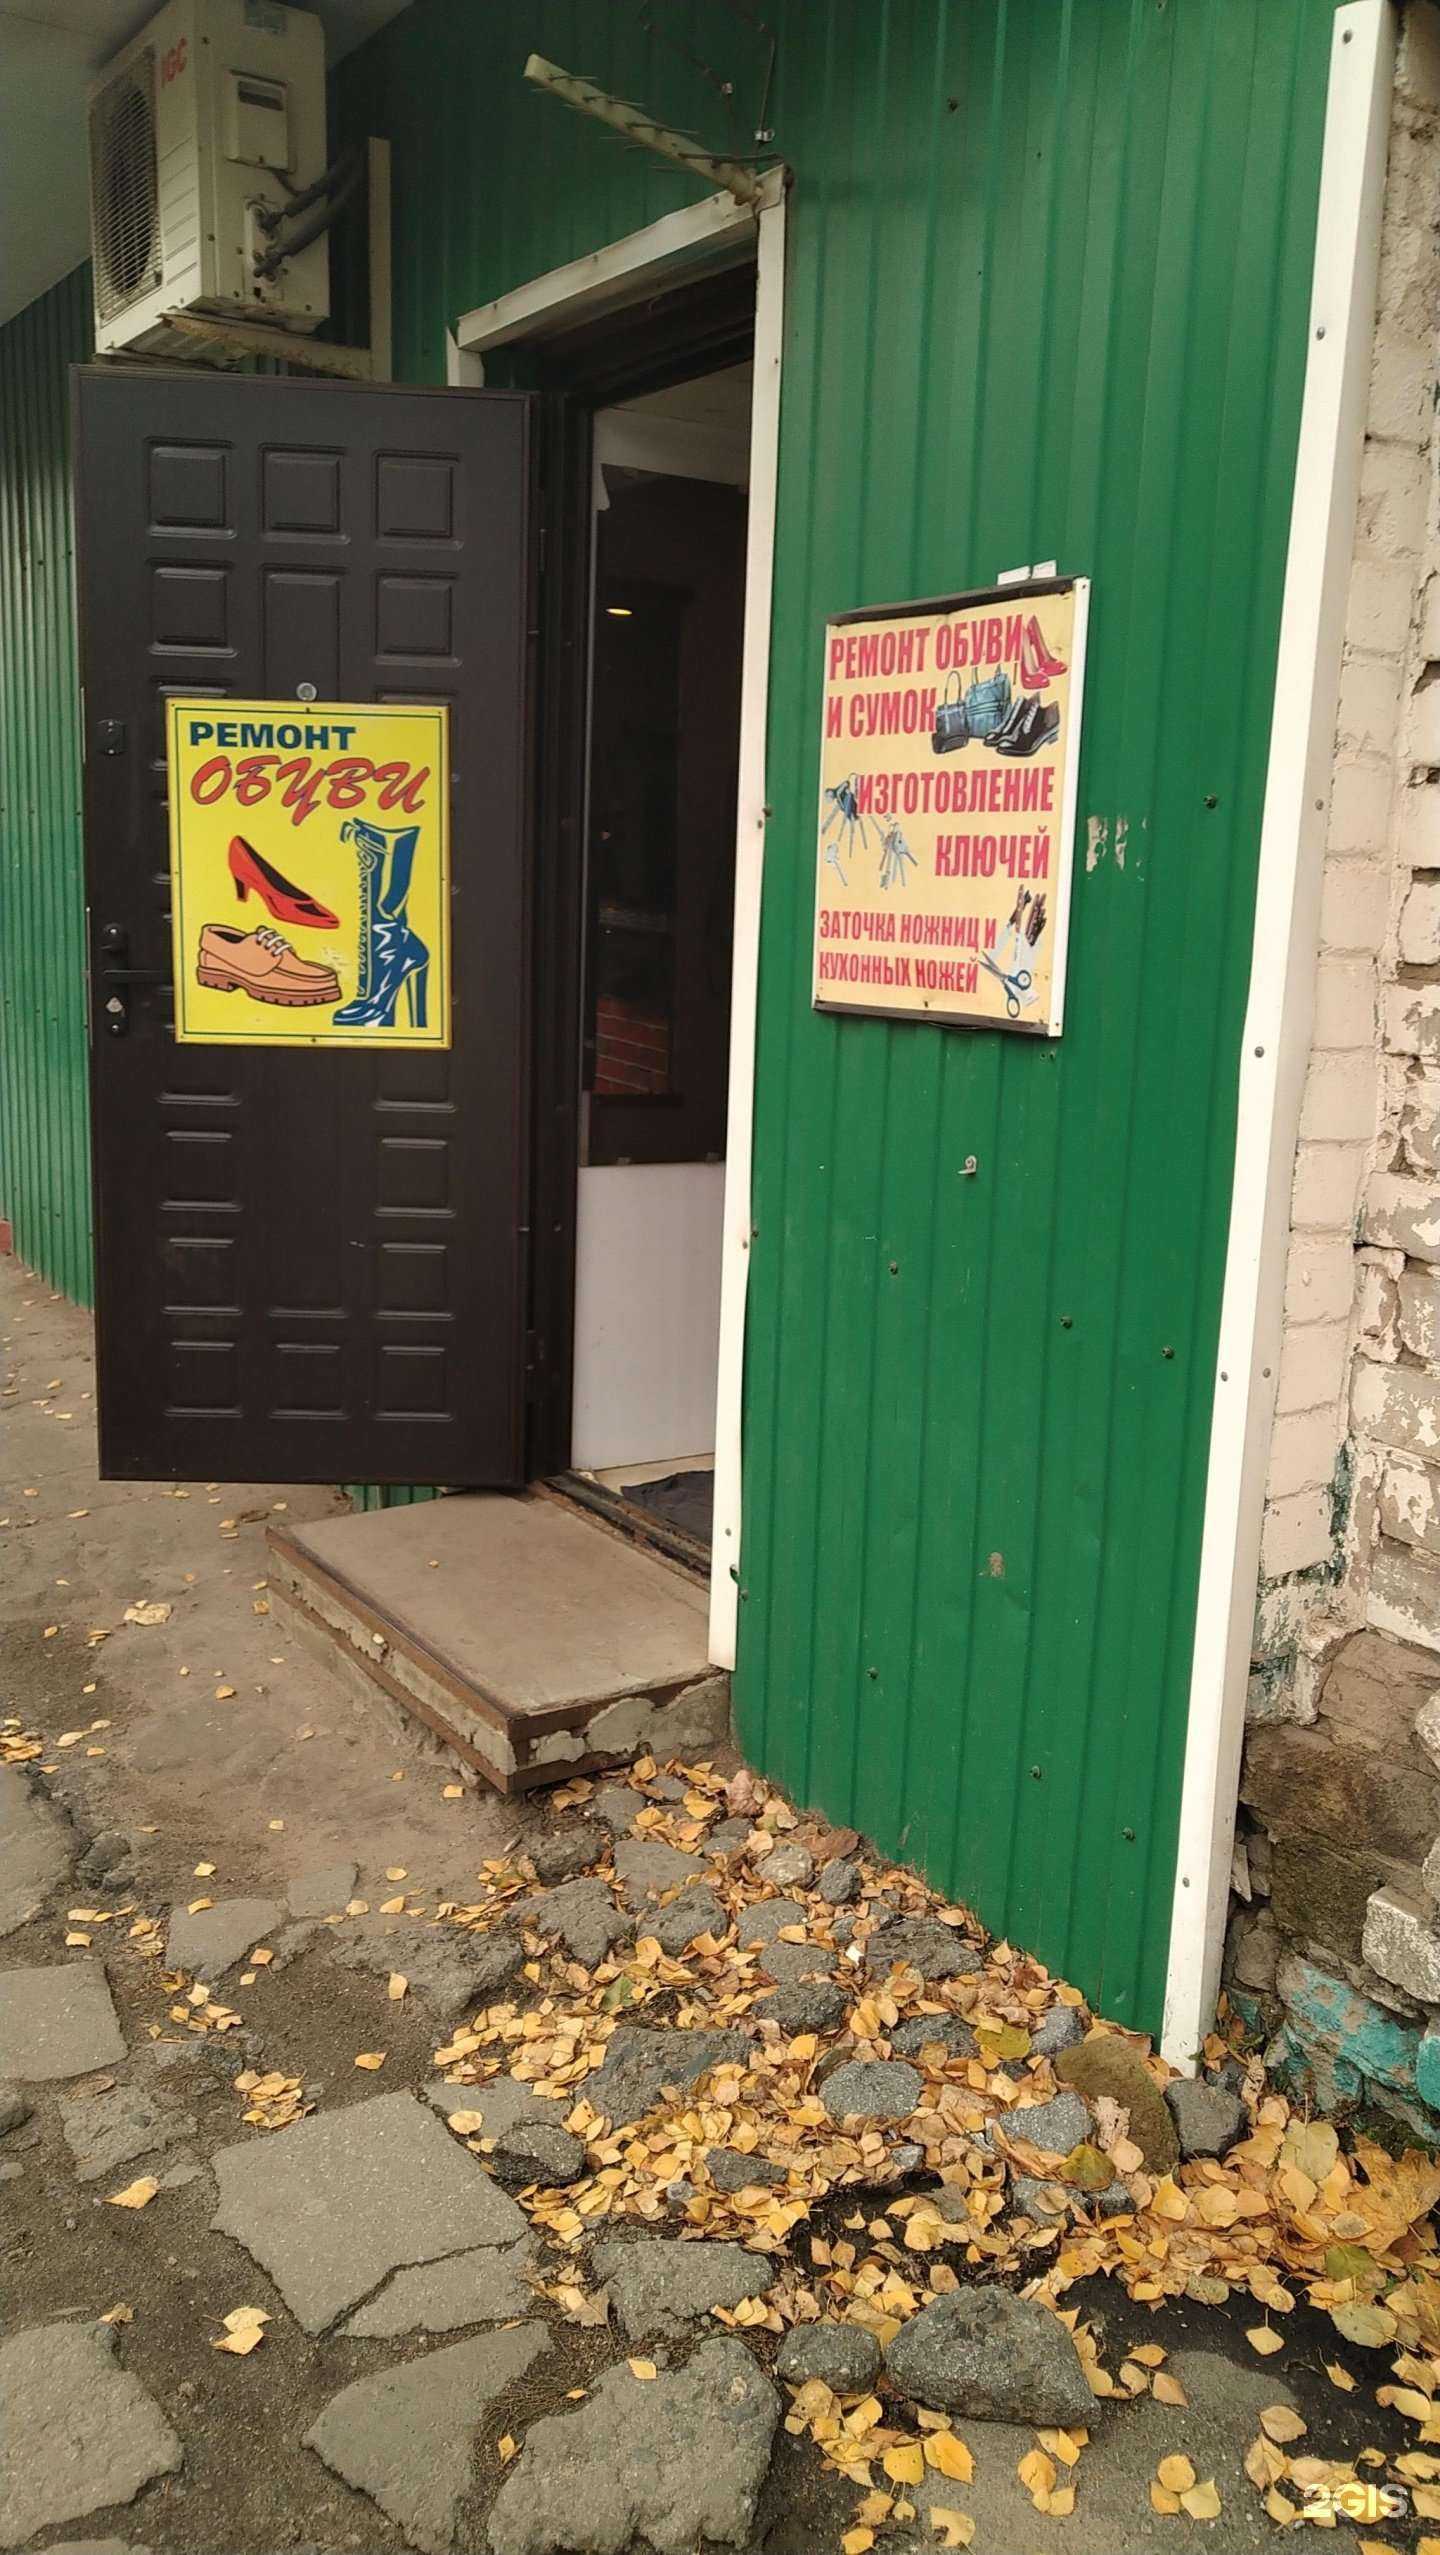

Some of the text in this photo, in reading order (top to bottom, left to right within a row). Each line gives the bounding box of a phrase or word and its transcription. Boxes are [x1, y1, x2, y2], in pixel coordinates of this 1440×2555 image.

[829, 614, 1024, 681] РЕМОНТ ОБУВИ
[189, 721, 356, 751] РЕМОНТ
[826, 688, 937, 738] И СУМОК
[190, 755, 431, 826] ОБУВИ
[857, 767, 1055, 815] ИЗГОТОВЛЕНИЕ
[935, 825, 1050, 879] КЛЮЧЕЙ
[819, 909, 997, 953] ЗАТОЧКА НОЖНИЦ И
[818, 951, 979, 994] КУХОННЫХ НОЖЕЙ
